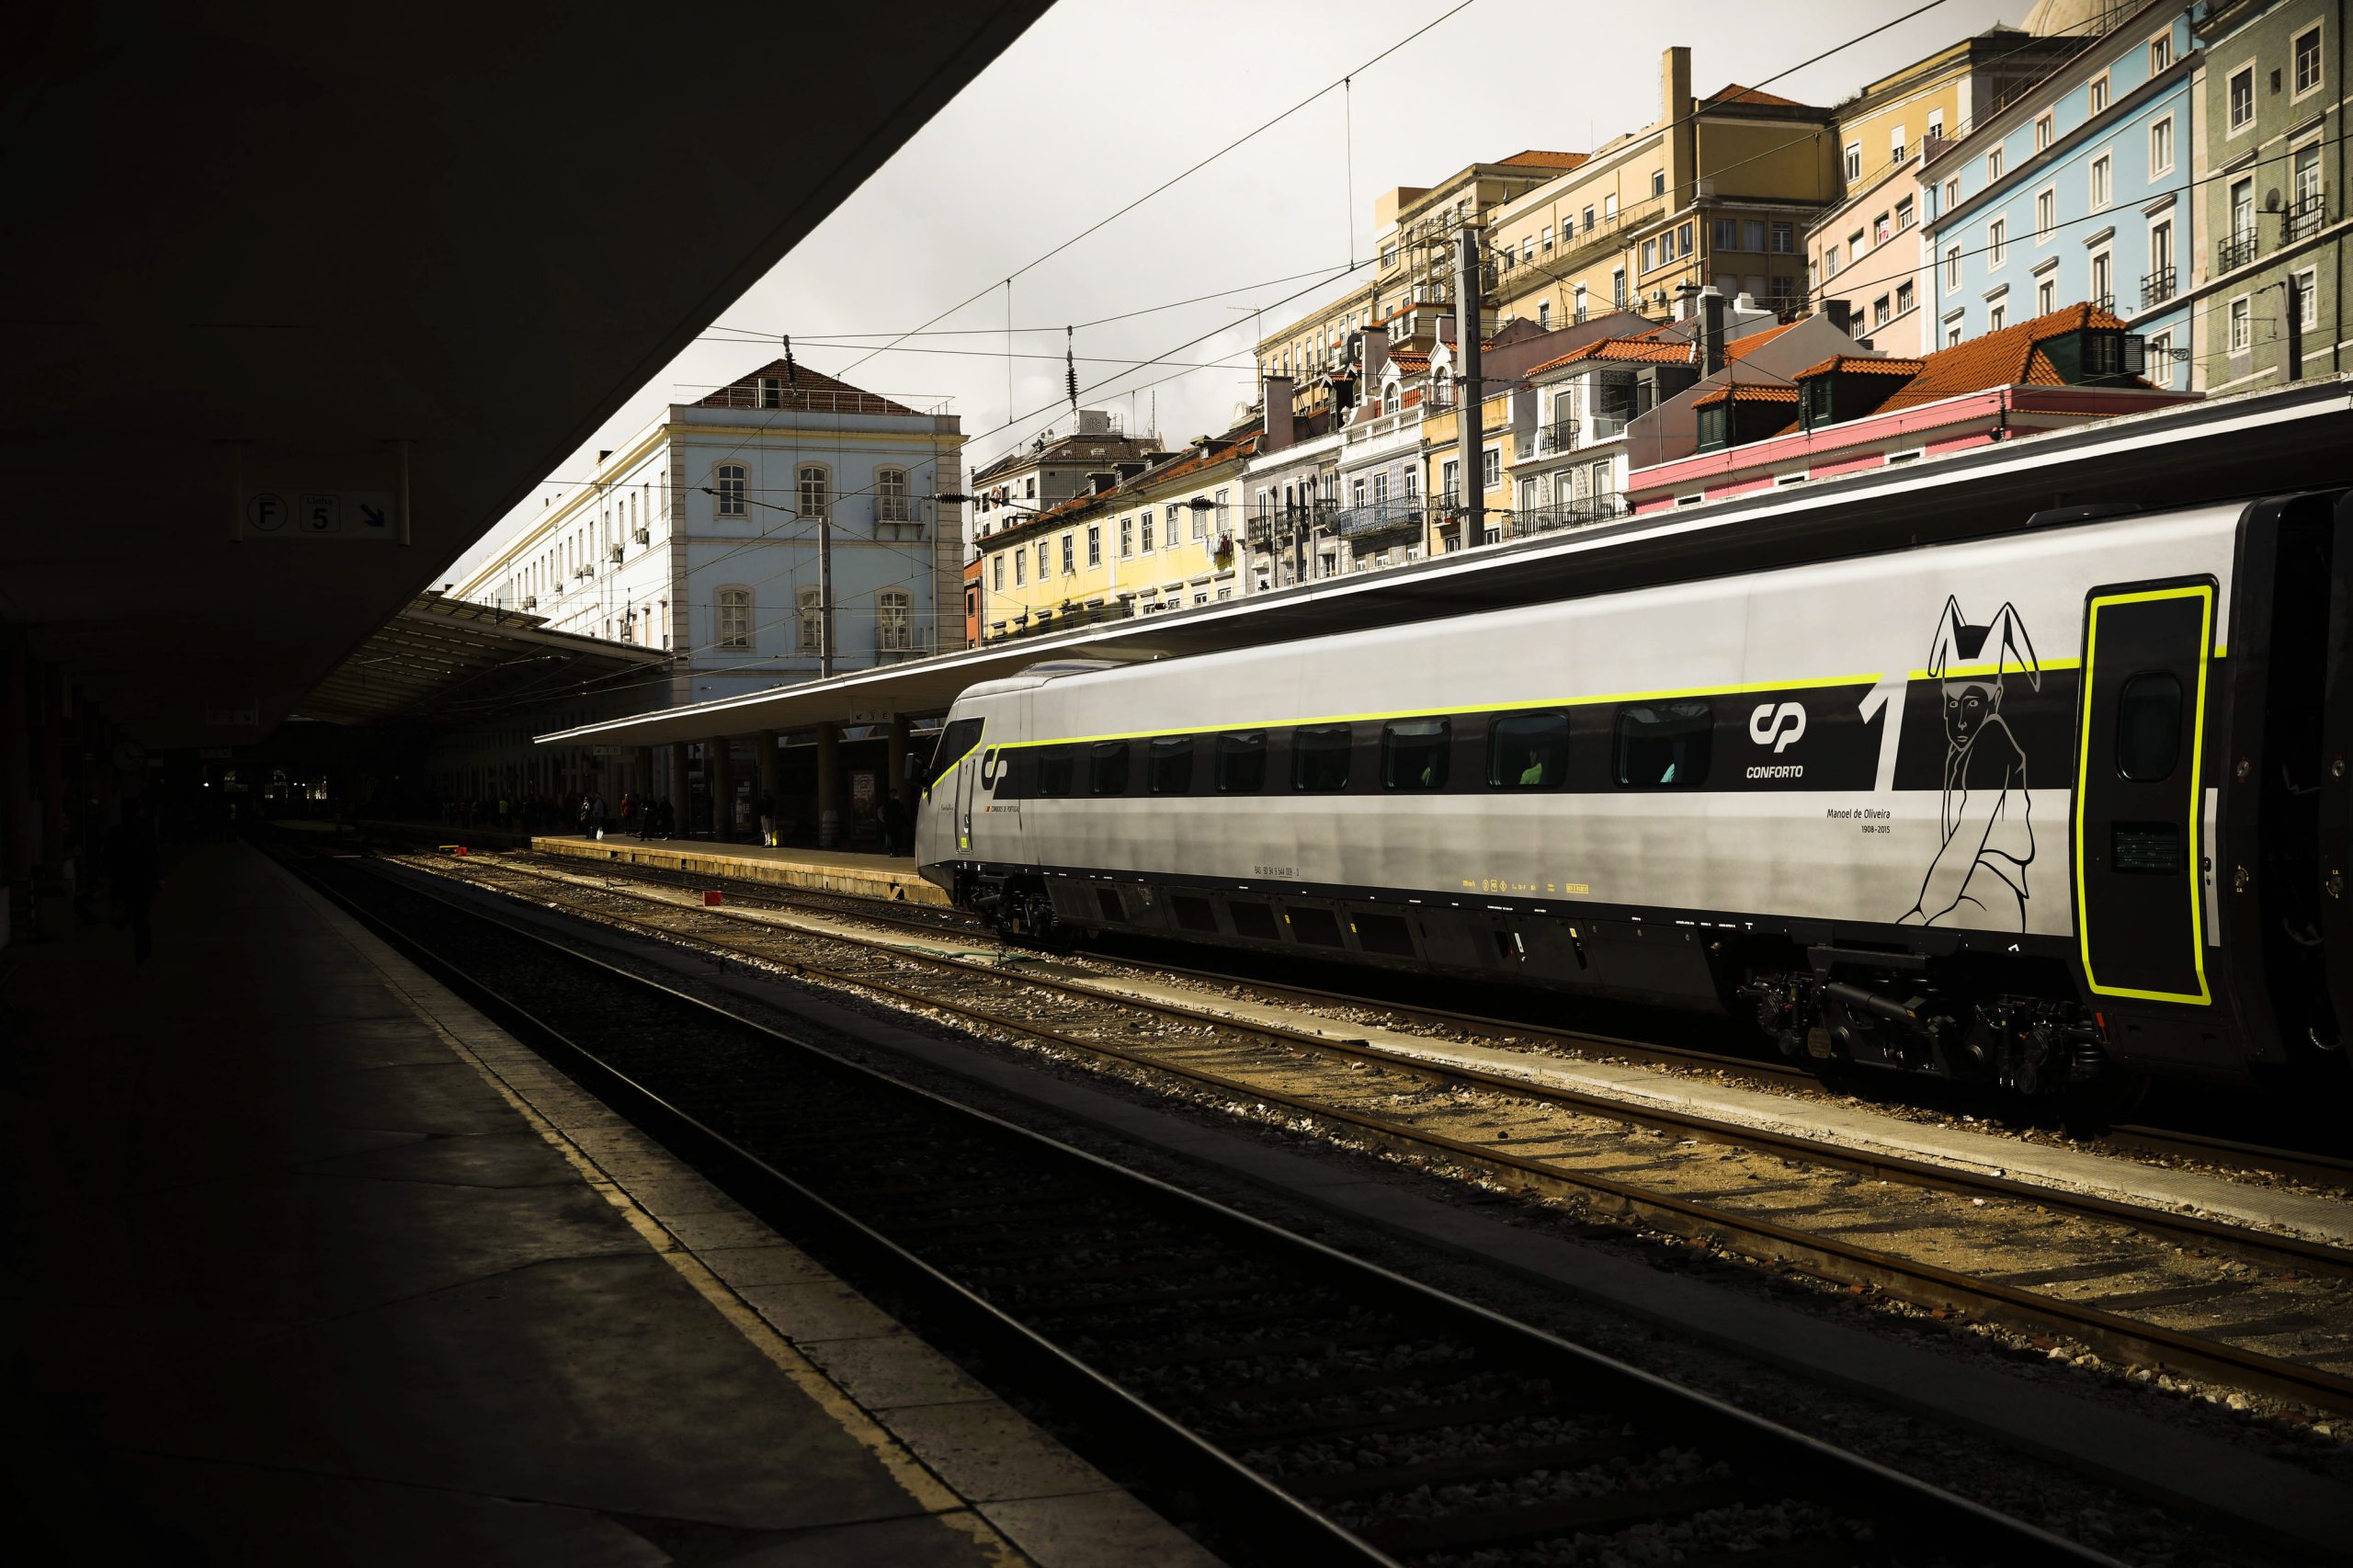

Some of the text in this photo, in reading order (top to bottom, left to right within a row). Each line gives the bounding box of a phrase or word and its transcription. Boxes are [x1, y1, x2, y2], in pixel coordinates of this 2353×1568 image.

[260, 502, 275, 524] F
[313, 508, 328, 529] 5
[1749, 701, 1807, 753] CP
[1858, 673, 1908, 791] 1
[1746, 766, 1803, 778] CONFORTO
[1826, 809, 1891, 819] Manoel de Oliveira
[1861, 825, 1891, 834] 1908-2015
